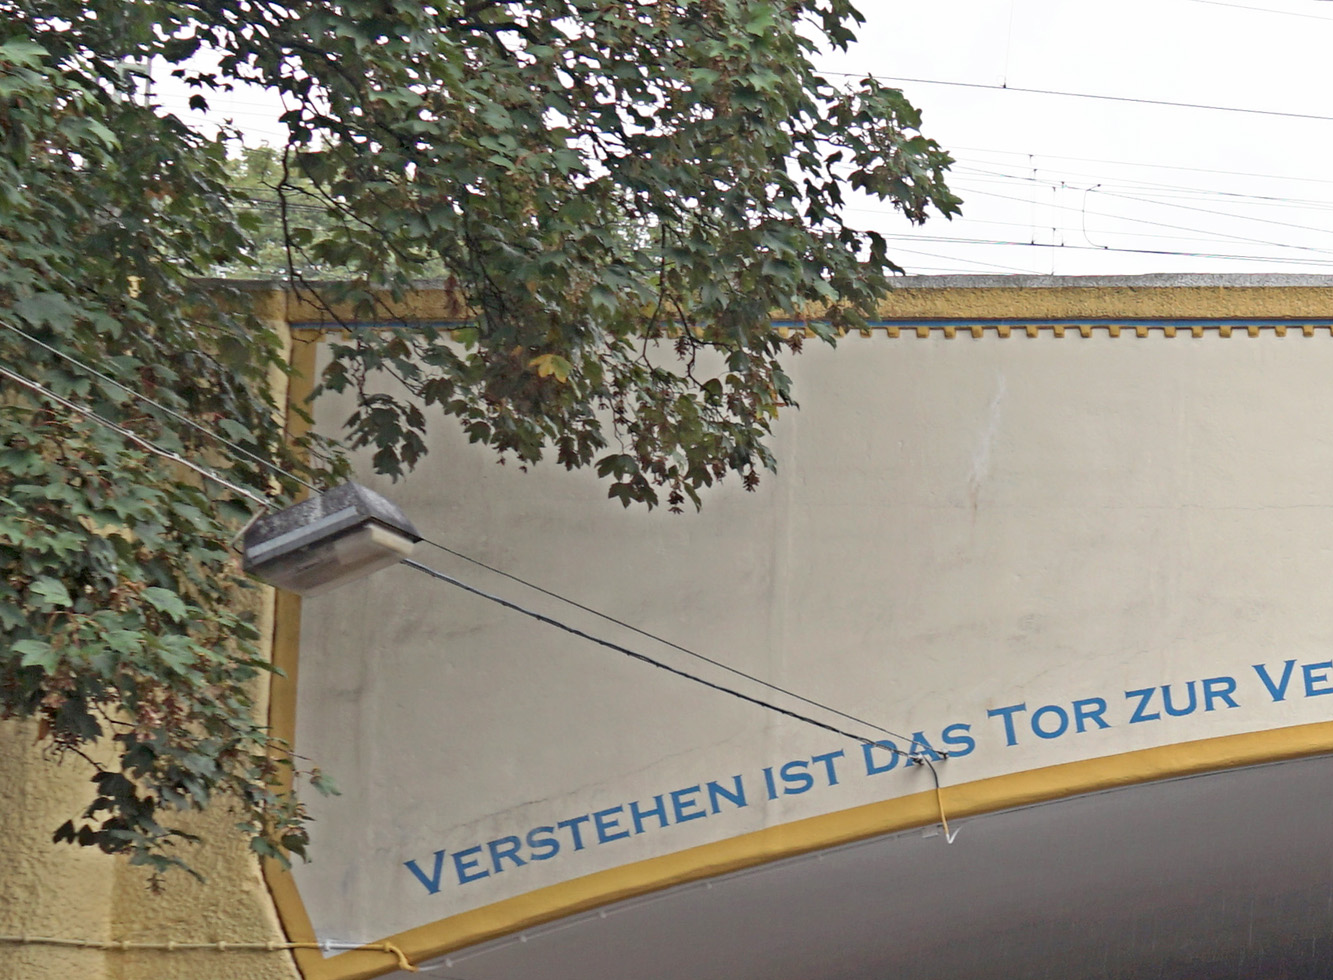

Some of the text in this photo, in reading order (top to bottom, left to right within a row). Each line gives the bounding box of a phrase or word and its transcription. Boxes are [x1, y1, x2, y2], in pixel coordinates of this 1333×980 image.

[405, 775, 747, 894] VERSTEHEN
[763, 749, 845, 800] IST
[862, 722, 976, 777] DAS
[987, 697, 1110, 747] TOR
[1124, 675, 1240, 724] ZUR
